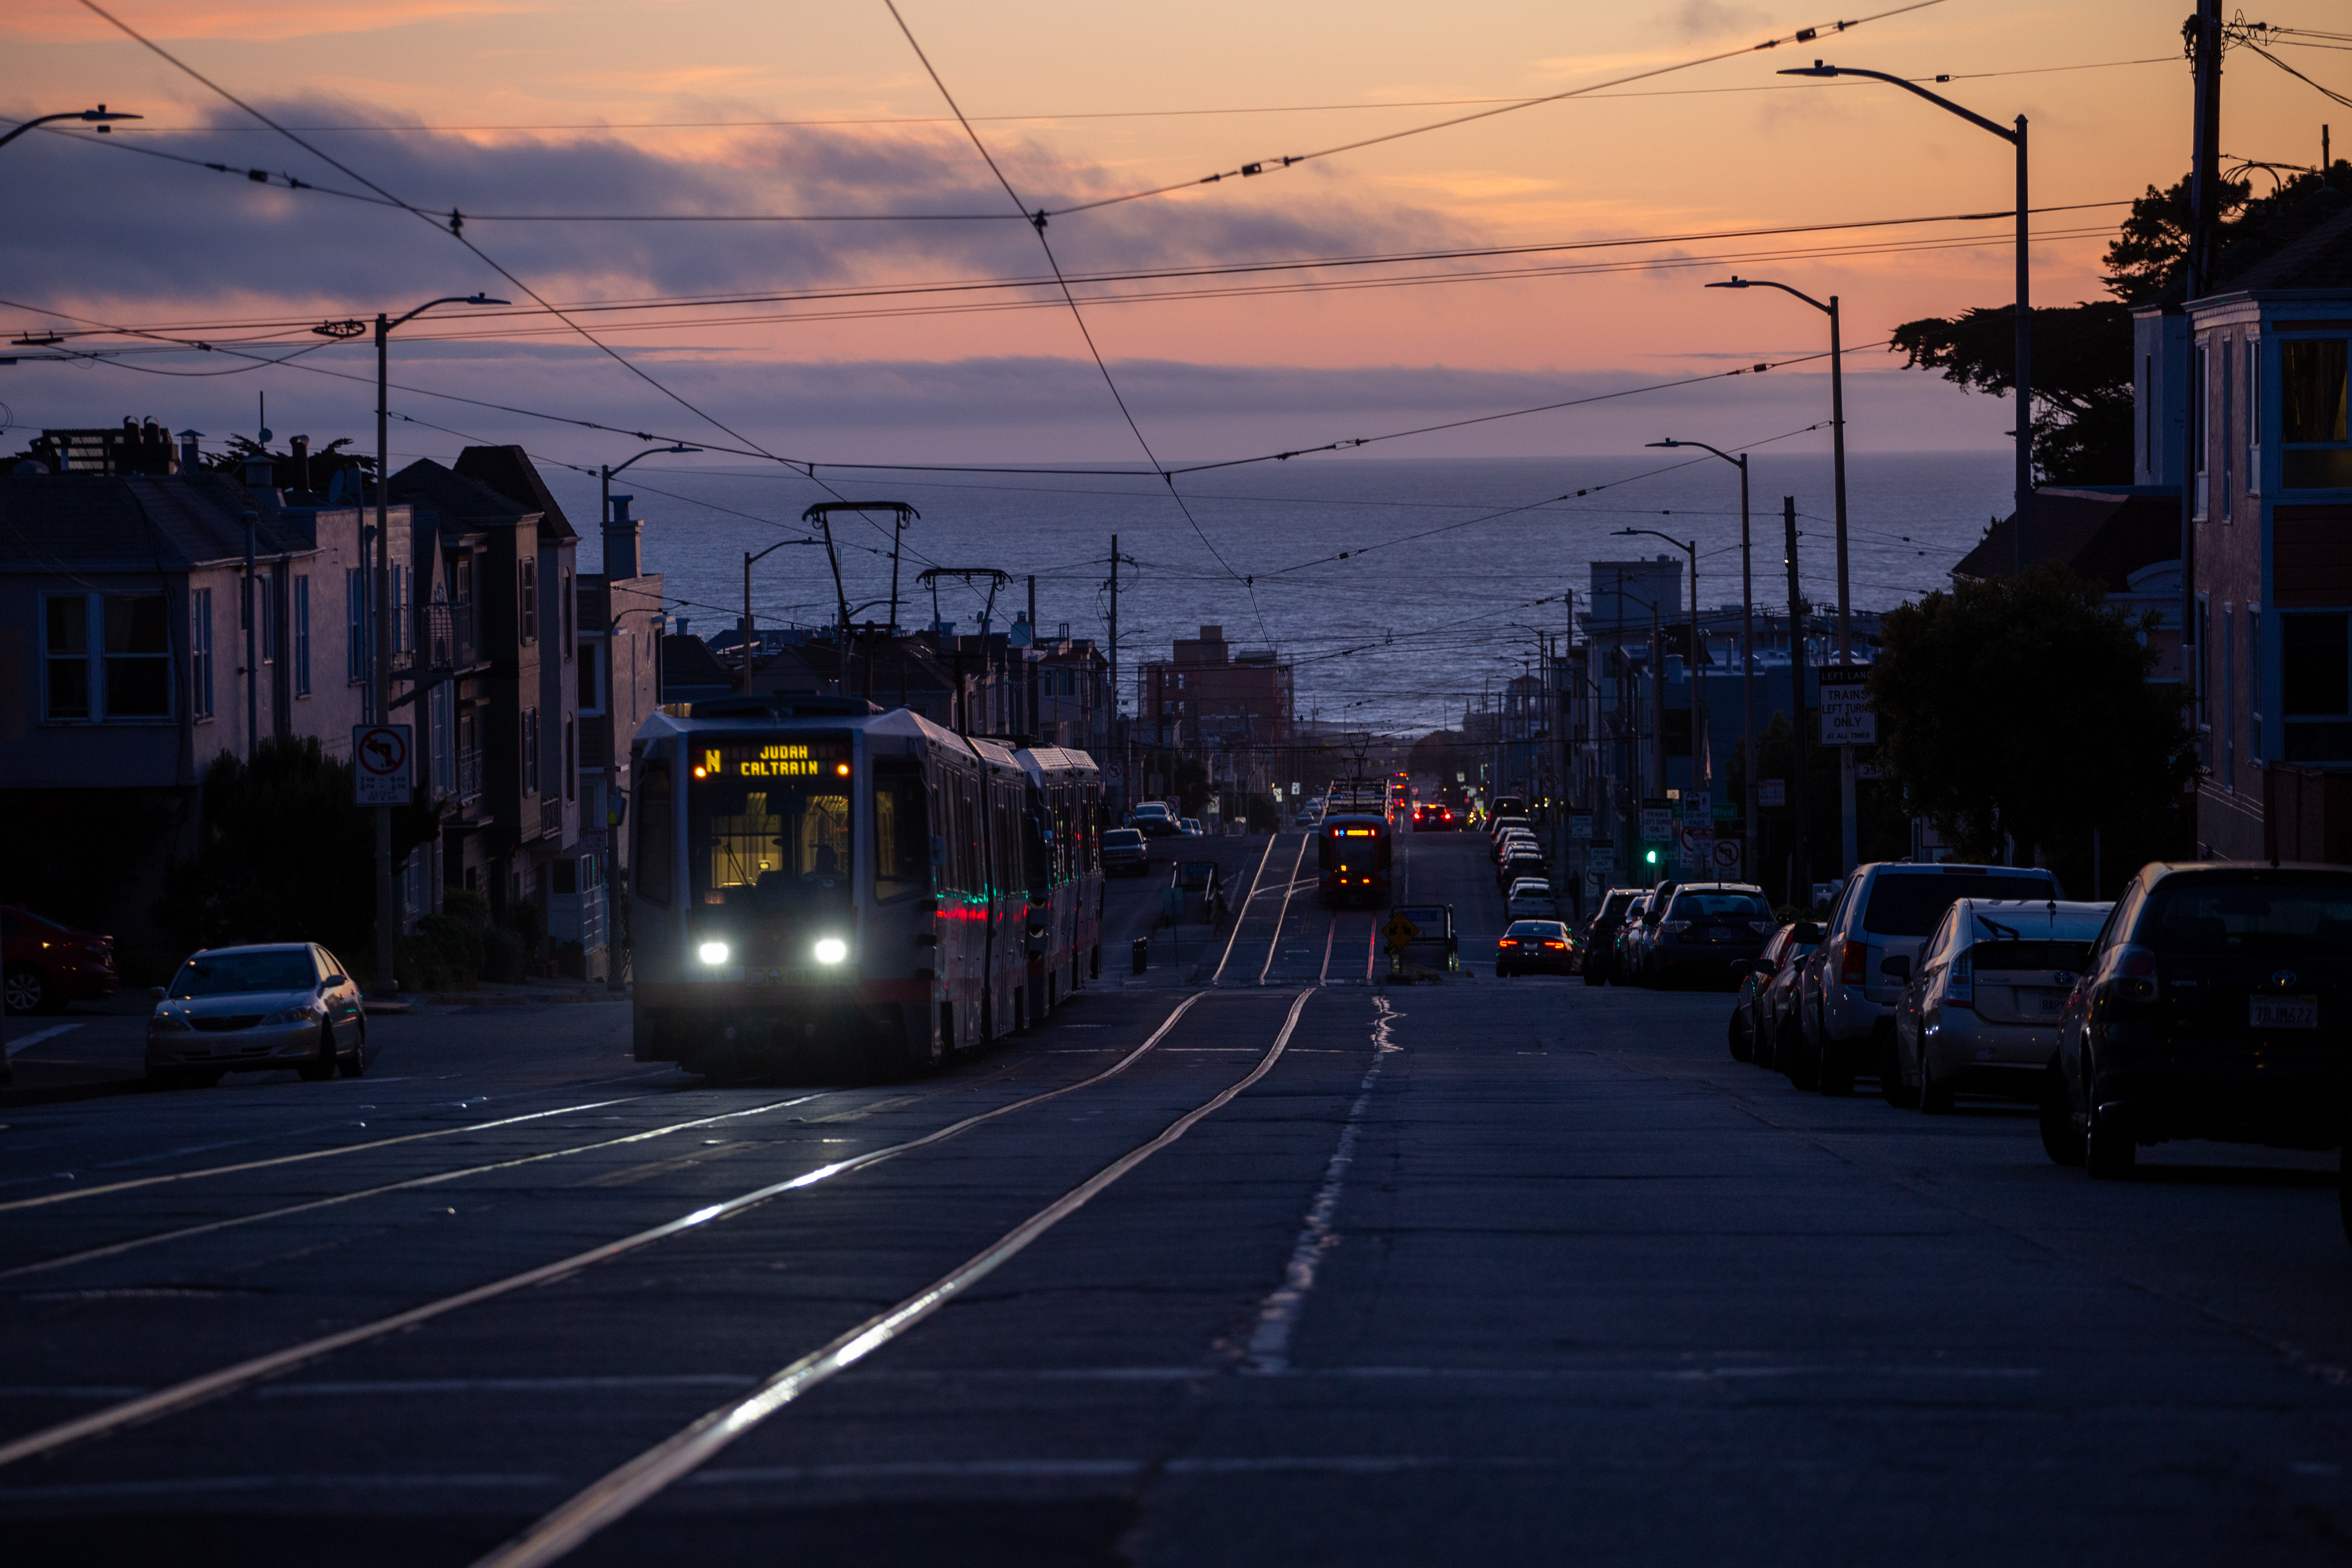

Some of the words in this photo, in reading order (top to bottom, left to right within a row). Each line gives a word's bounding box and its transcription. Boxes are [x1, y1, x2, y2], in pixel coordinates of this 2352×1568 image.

[1822, 672, 1844, 681] LEFT
[1828, 690, 1868, 700] TRAINS
[1822, 704, 1843, 714] LEFT
[1834, 717, 1862, 727] ONLY
[760, 745, 808, 760] JUDAH
[705, 748, 721, 773] N
[740, 760, 818, 776] CALTRAIN
[1712, 807, 1734, 816] Blvd
[2255, 1007, 2313, 1022] 7BJM622
